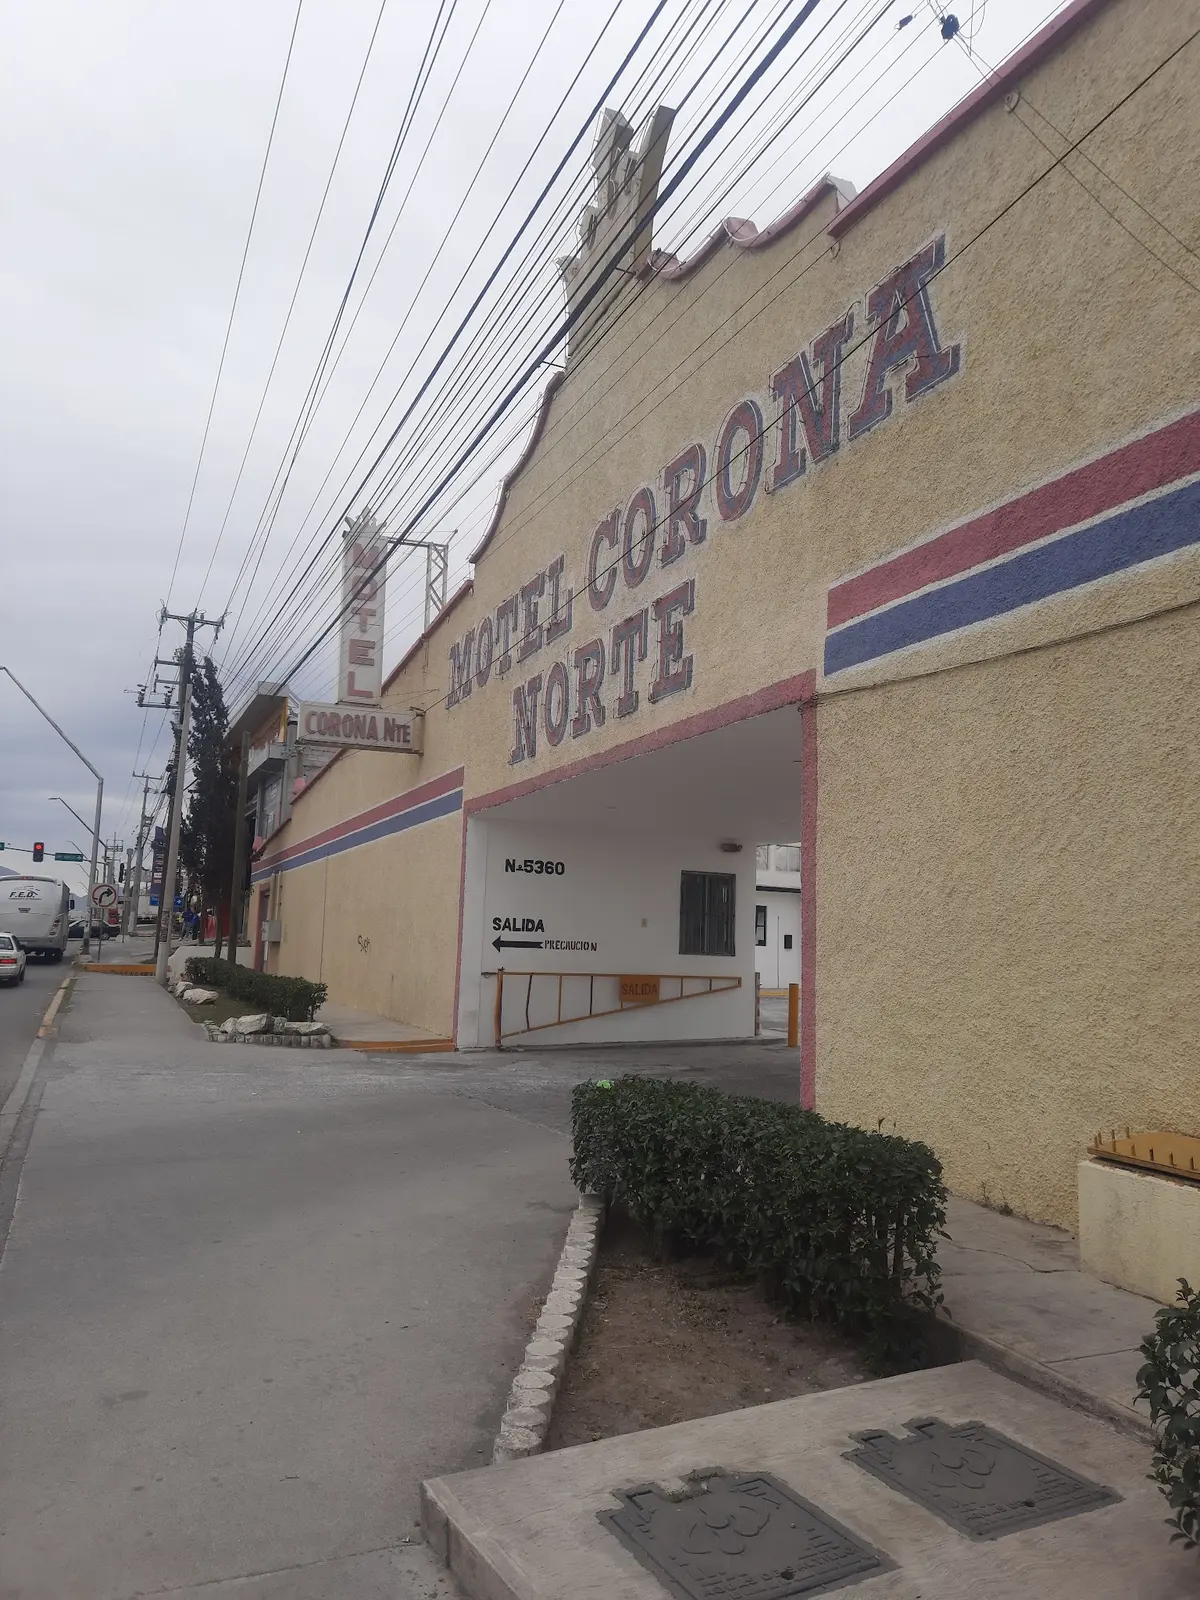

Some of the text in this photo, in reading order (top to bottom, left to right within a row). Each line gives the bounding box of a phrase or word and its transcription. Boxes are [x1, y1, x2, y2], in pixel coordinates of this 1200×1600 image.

[445, 233, 962, 710] MOTEL CORONA
[346, 541, 379, 699] MOTEL
[508, 577, 696, 765] NORTE
[305, 710, 378, 740] CORONA
[492, 917, 545, 932] SALIDA
[544, 939, 598, 951] PRECAUCION
[621, 982, 659, 997] SALIDA
